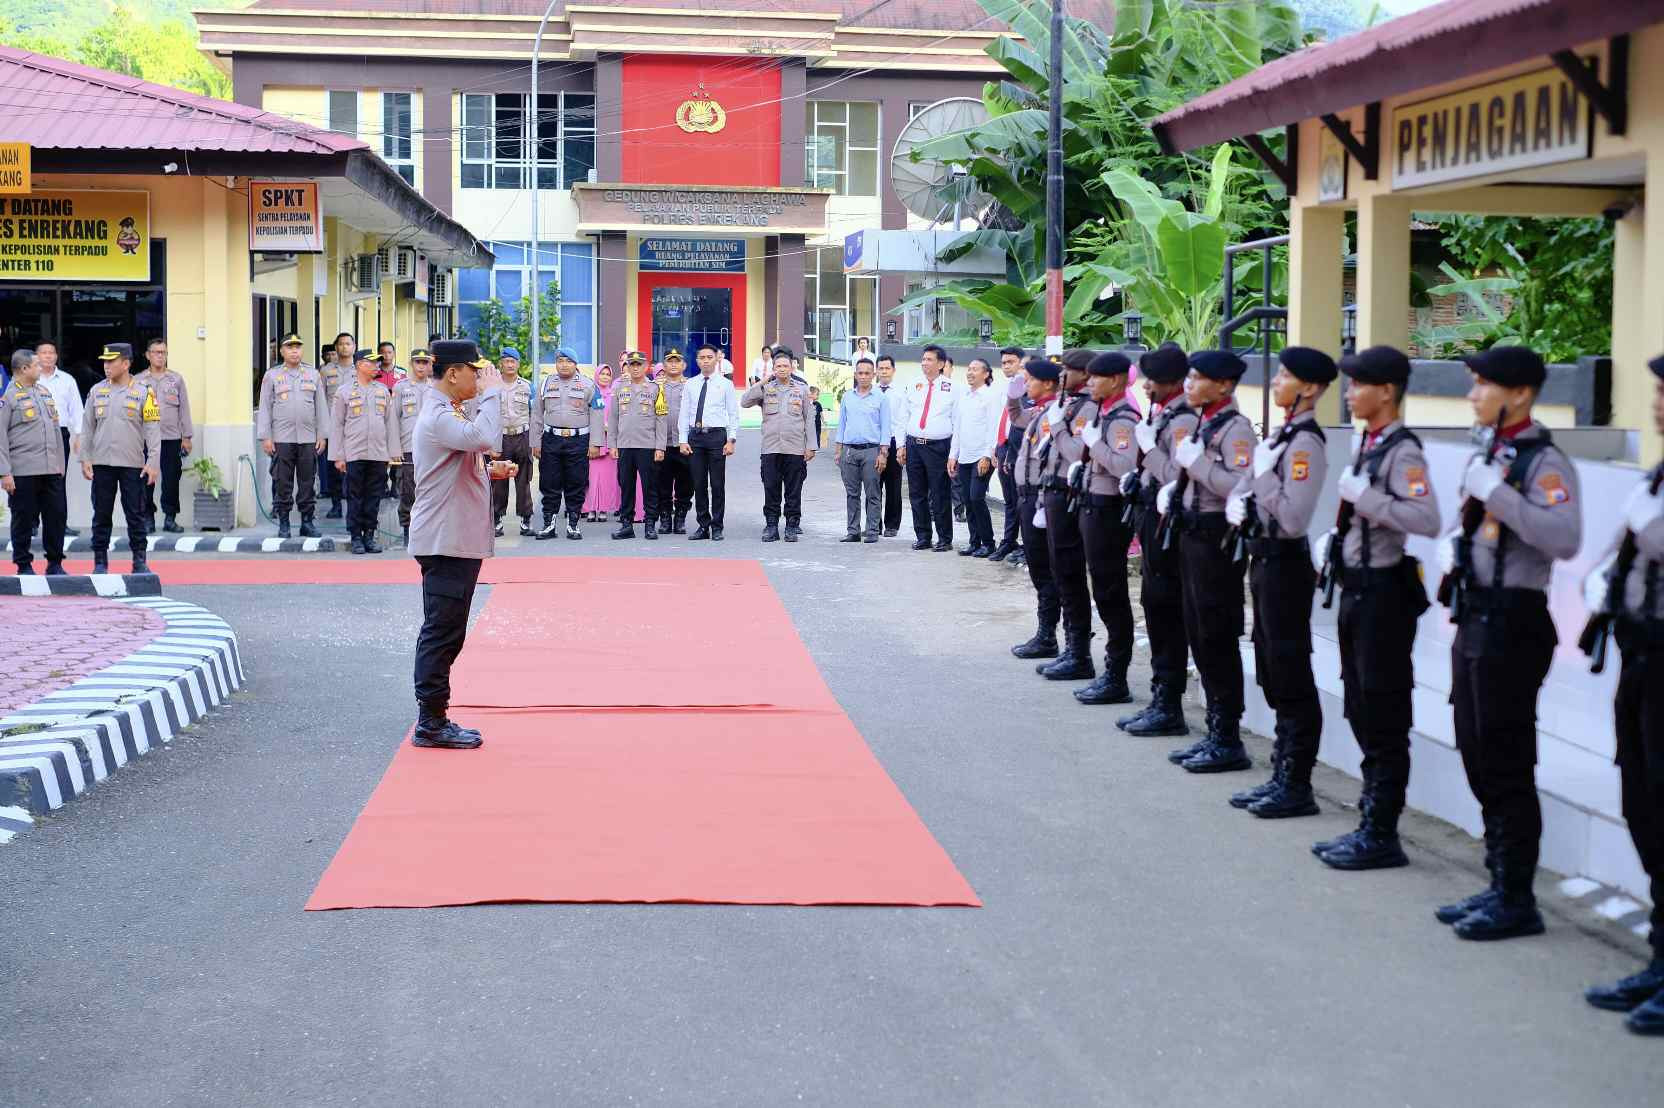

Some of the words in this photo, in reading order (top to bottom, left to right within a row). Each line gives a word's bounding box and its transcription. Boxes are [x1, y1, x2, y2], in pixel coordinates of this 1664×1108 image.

[1399, 81, 1579, 176] PENJAGAAN
[262, 189, 304, 207] SPKT
[604, 190, 660, 203] GEDUNG
[11, 198, 73, 216] DATANG
[257, 212, 279, 222] SENTRA
[643, 214, 695, 225] POLRES
[700, 214, 768, 227] ENREKANG
[19, 219, 108, 240] ENREKANG
[256, 226, 288, 235] KEPOLISIAN
[289, 226, 313, 235] TERPADU
[1, 244, 60, 256] KEPOLISIAN
[62, 244, 108, 257] TERPADU
[647, 240, 691, 251] SELAMAT
[696, 241, 738, 252] DATANG
[685, 252, 730, 261] PELAYANAN
[34, 259, 54, 272] 110
